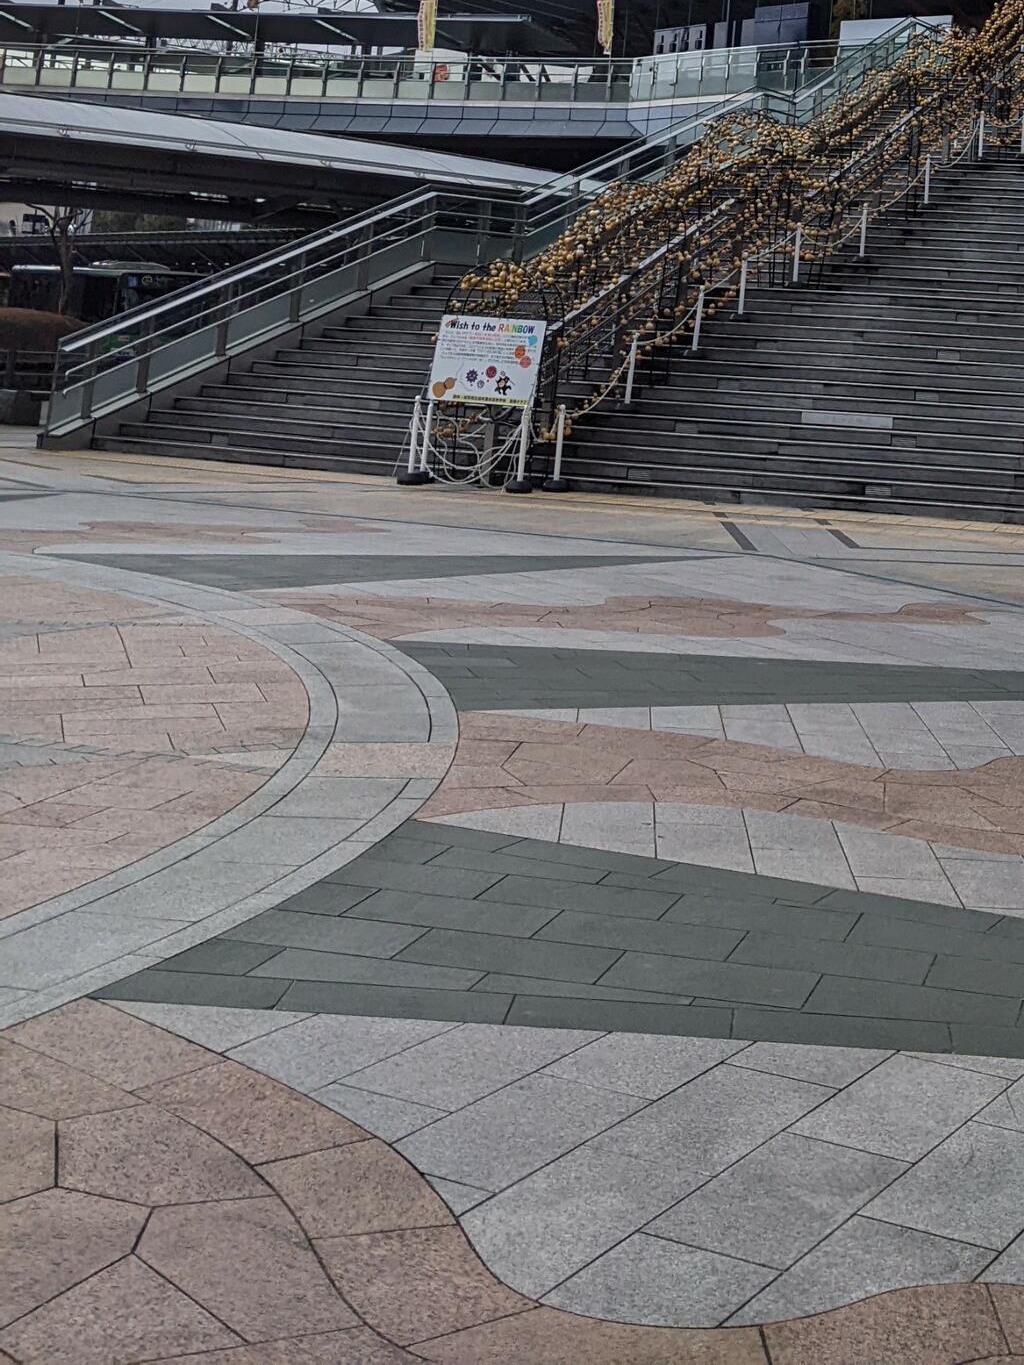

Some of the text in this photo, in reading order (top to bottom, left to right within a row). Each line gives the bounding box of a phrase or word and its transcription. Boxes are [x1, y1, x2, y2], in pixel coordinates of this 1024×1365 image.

[450, 319, 535, 334] Wish to the RAINBOW
